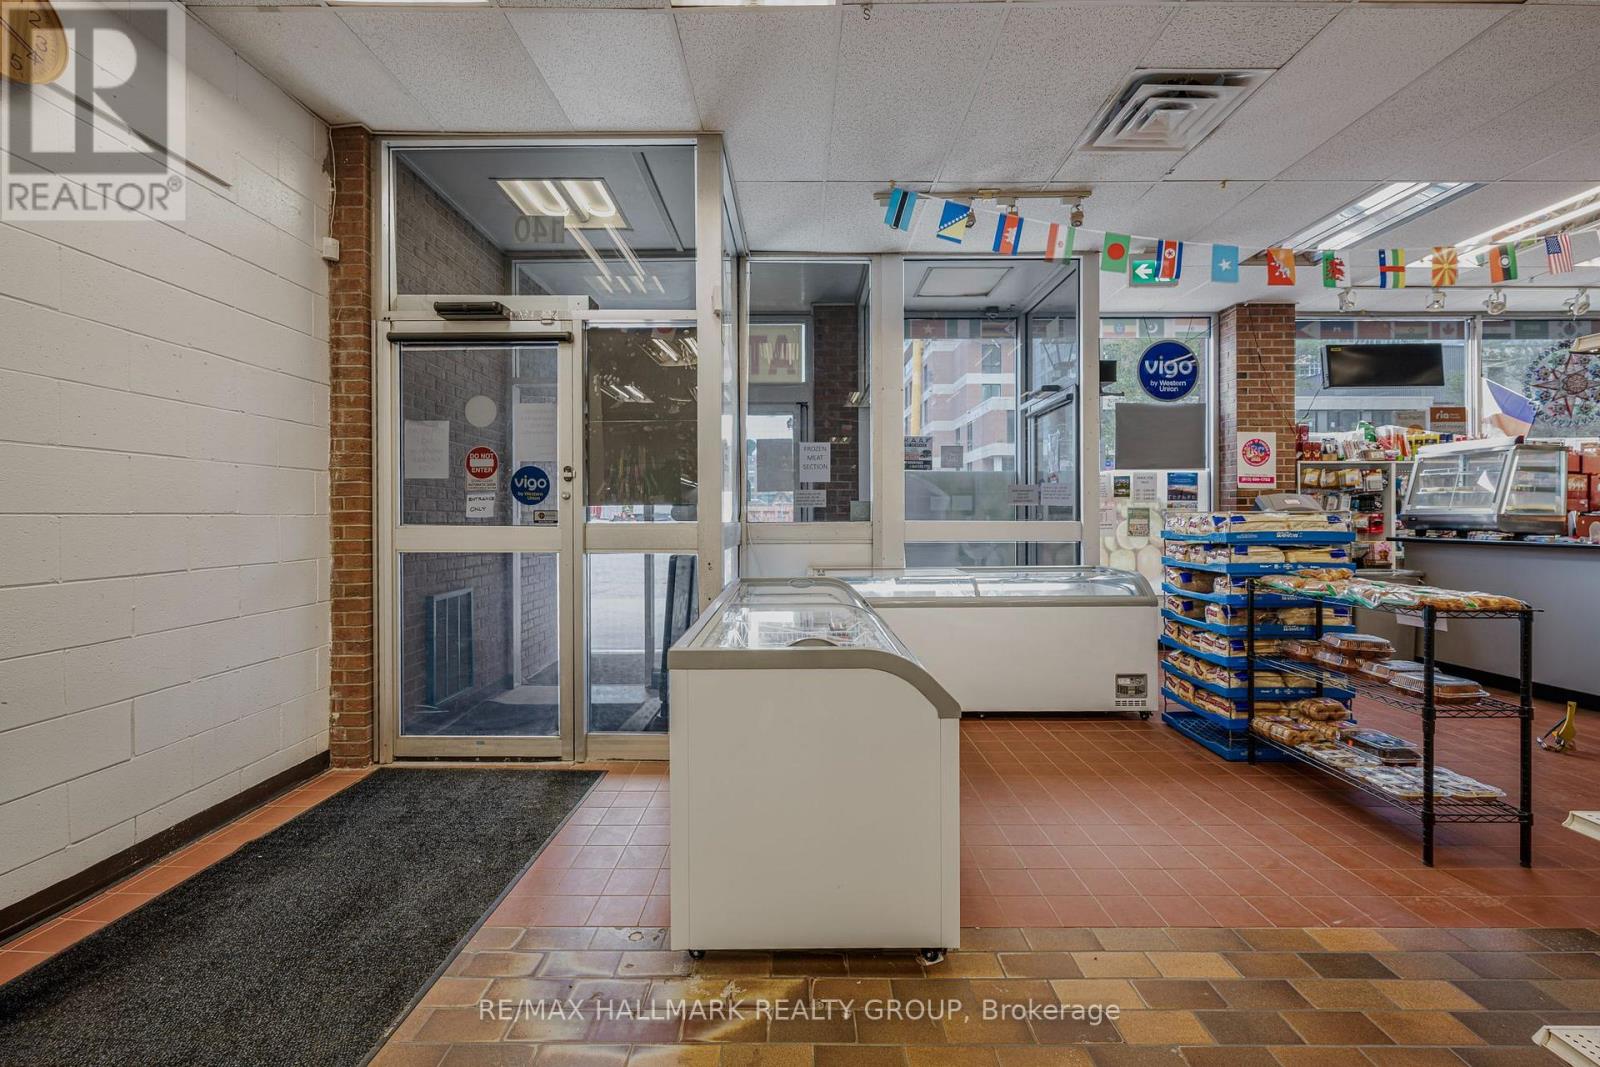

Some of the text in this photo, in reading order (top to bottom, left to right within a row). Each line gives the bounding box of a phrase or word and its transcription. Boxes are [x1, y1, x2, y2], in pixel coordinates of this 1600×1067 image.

[1144, 355, 1194, 379] vigo
[1150, 380, 1159, 388] by
[471, 466, 493, 474] ENTER
[514, 475, 547, 491] vigo
